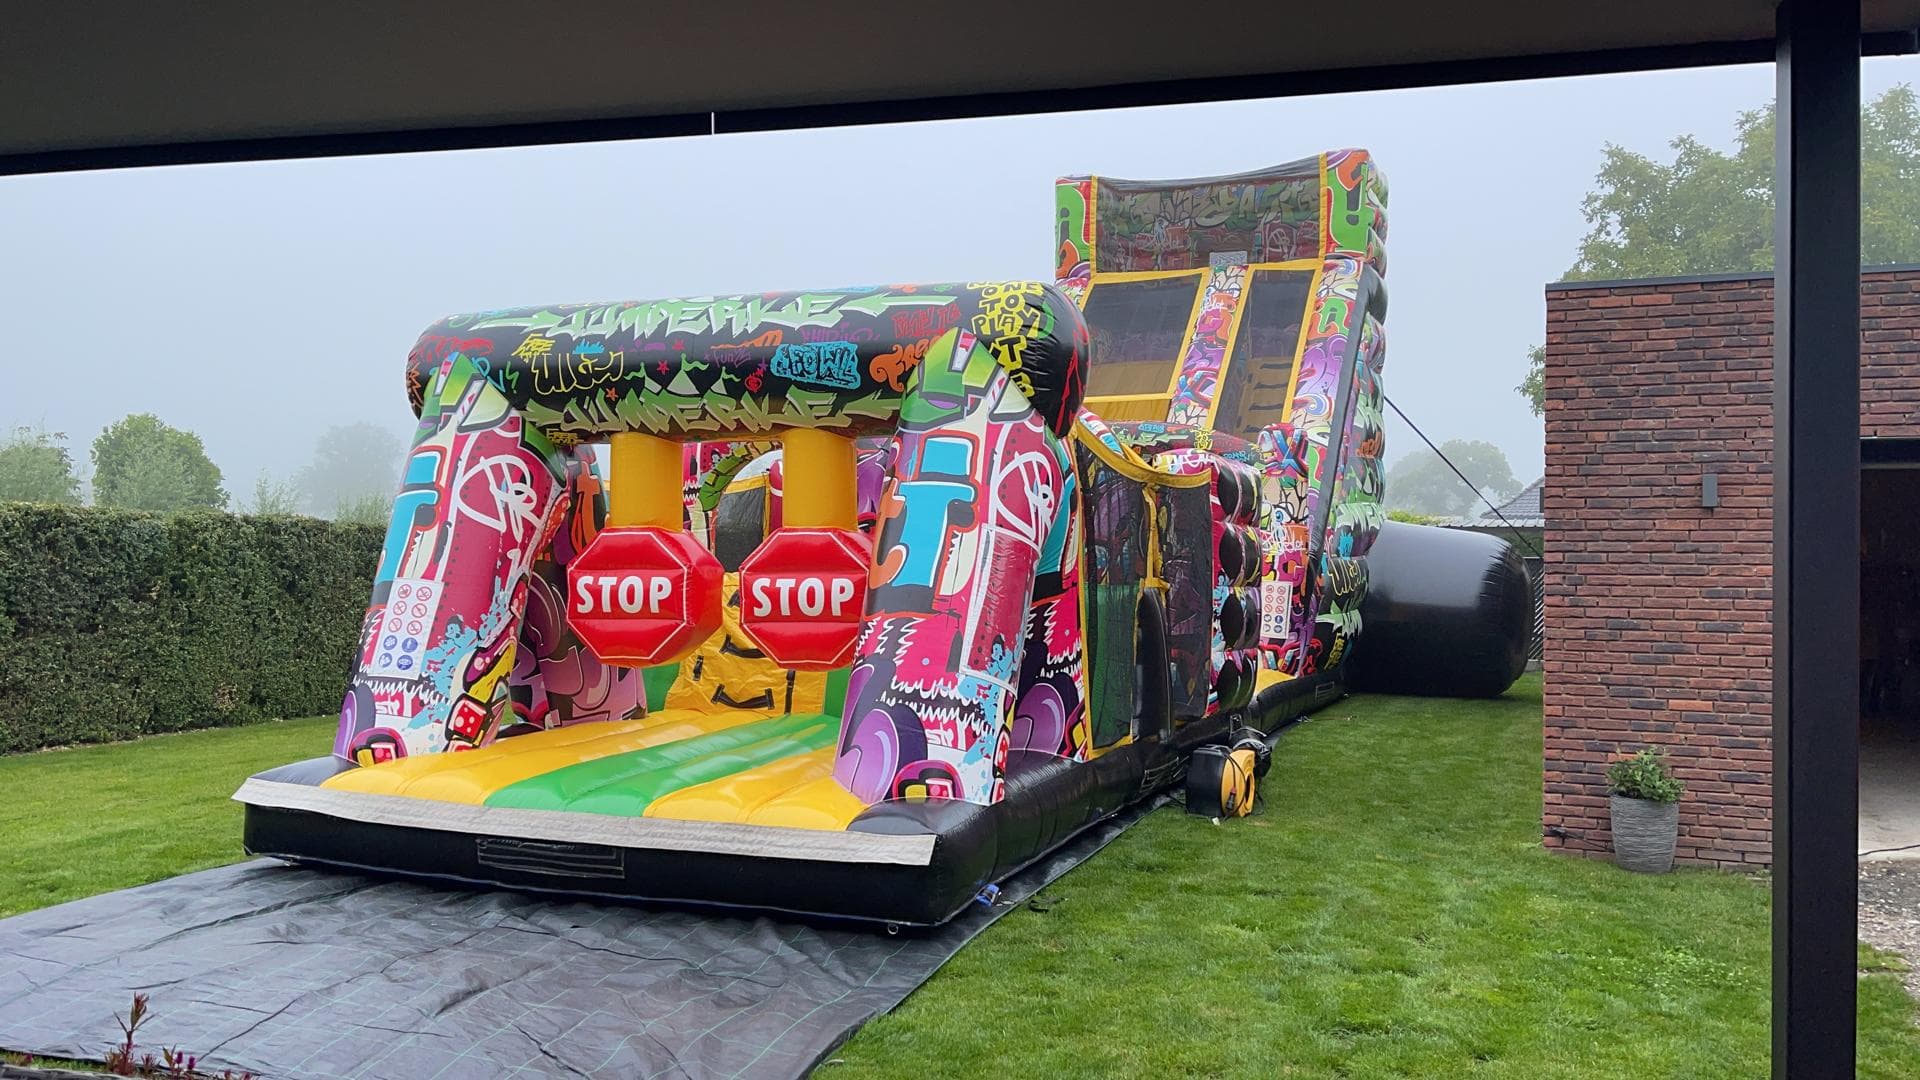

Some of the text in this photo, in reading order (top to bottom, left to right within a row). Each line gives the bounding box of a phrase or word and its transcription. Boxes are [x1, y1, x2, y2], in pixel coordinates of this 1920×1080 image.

[972, 307, 1040, 338] PLAY
[576, 575, 672, 614] STOP
[752, 577, 855, 617] STOP
